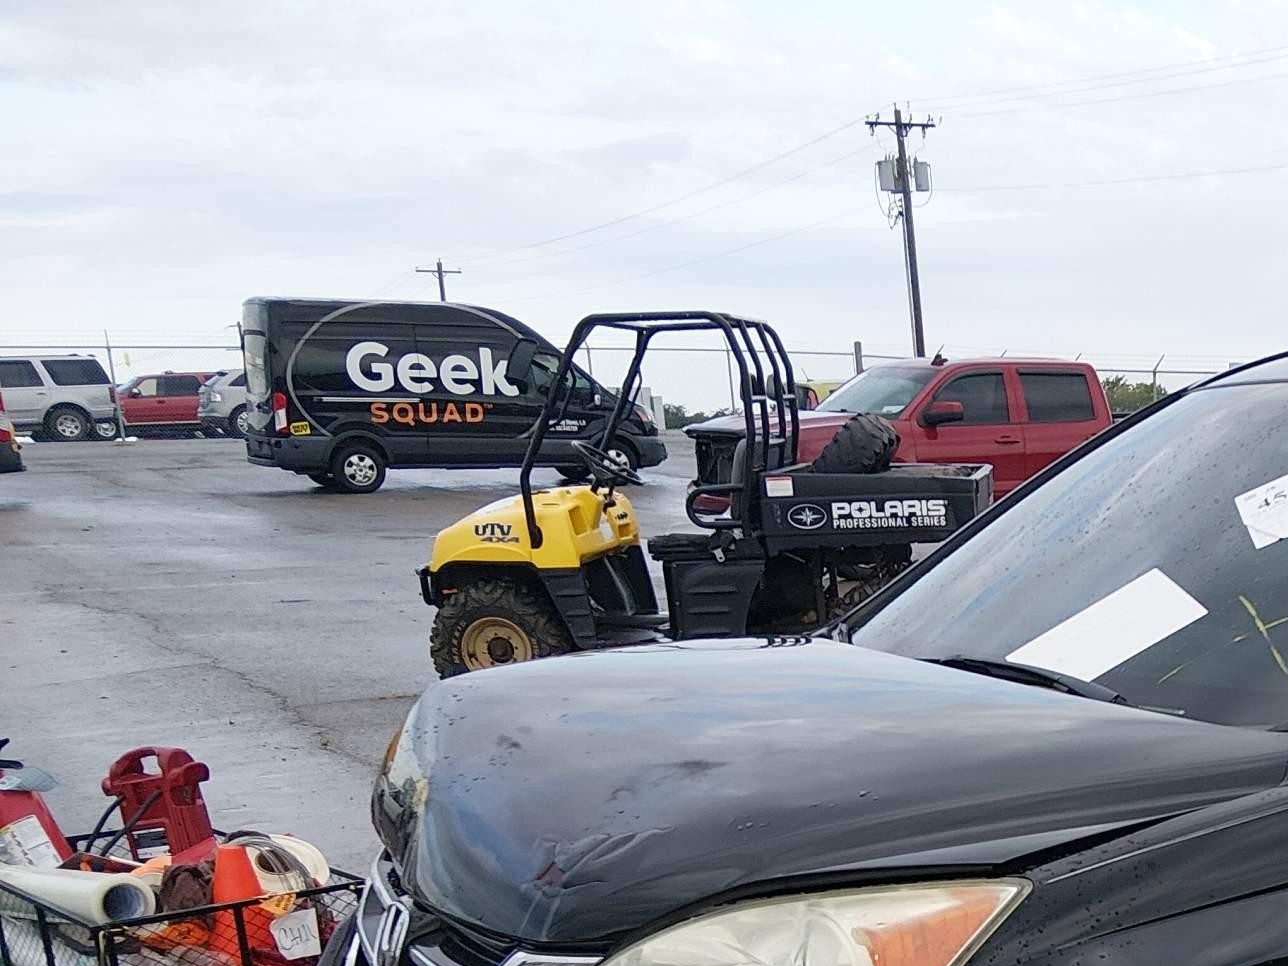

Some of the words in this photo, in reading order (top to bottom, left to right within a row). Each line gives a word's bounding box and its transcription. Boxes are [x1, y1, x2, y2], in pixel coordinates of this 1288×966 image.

[346, 341, 520, 397] Geek
[370, 402, 485, 426] SQUAD
[831, 500, 947, 518] POLARIS
[474, 523, 512, 537] UTV
[833, 516, 909, 529] PROFESSIONAL
[911, 516, 946, 528] SERIES
